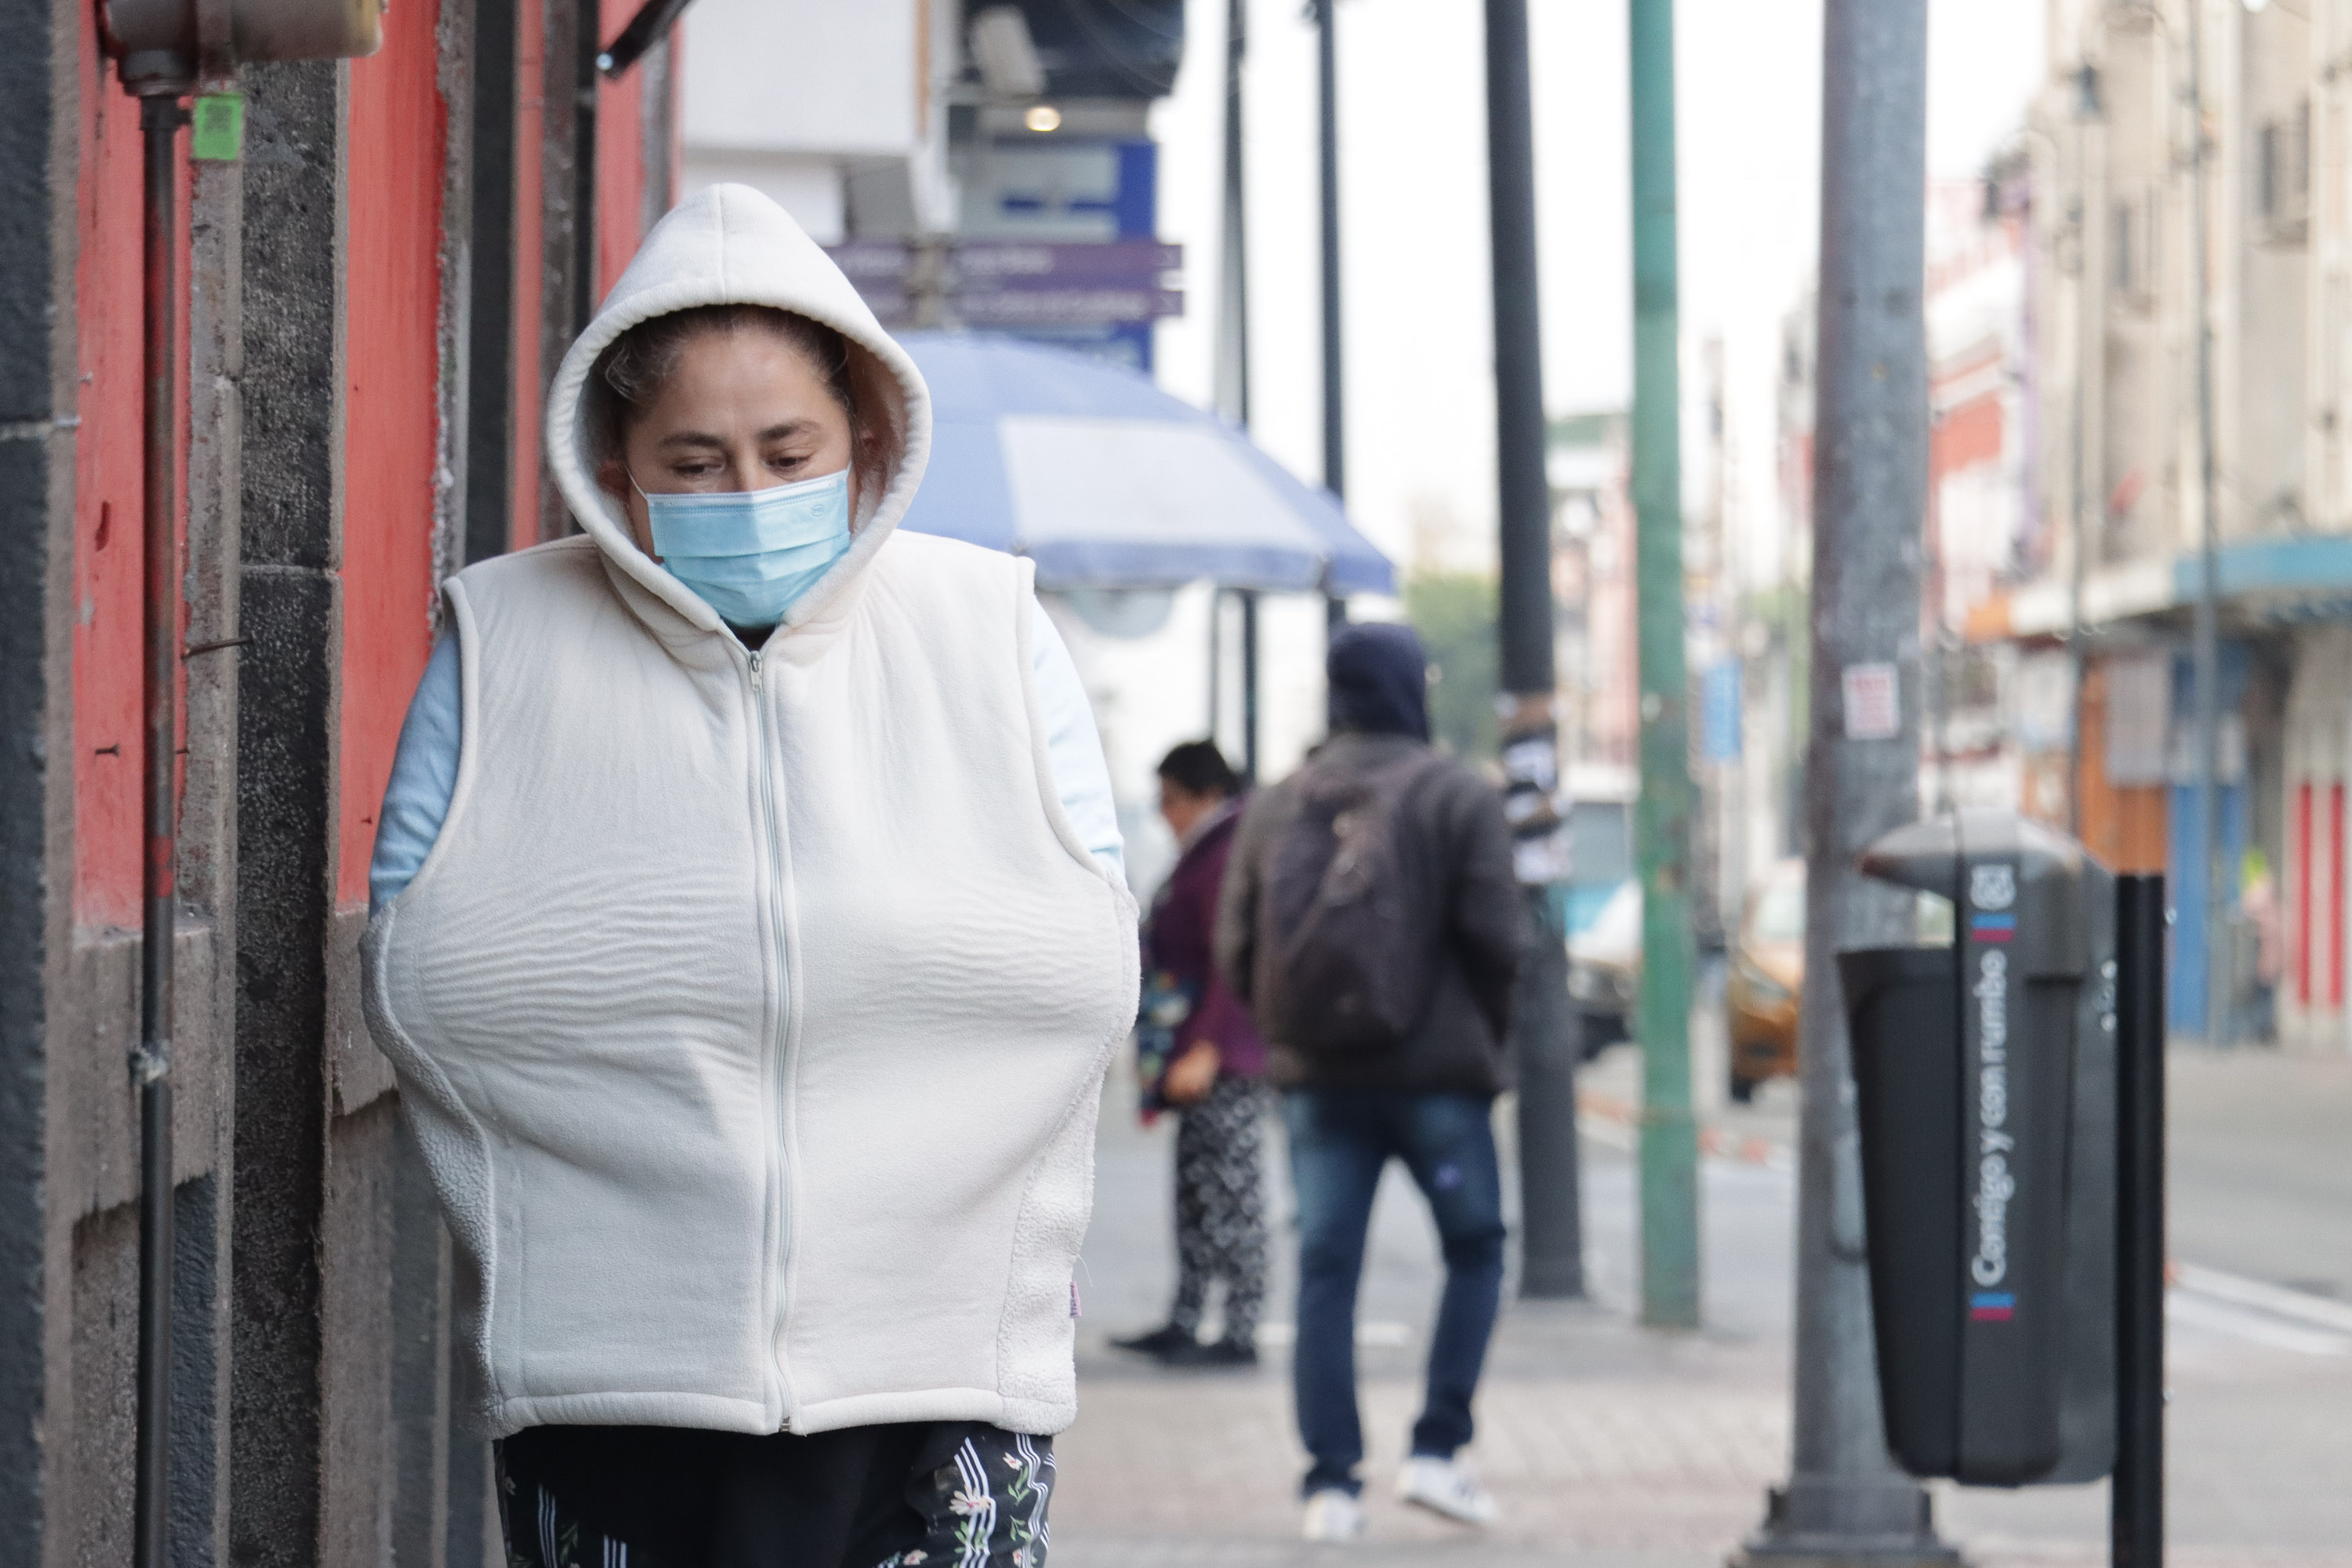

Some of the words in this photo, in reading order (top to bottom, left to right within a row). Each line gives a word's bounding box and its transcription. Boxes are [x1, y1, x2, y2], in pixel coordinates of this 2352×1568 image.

[1972, 949, 2007, 1063] rumbo
[1980, 1065, 2007, 1127] con
[1980, 1127, 2014, 1153] y
[1971, 1154, 2014, 1286] Contigo
